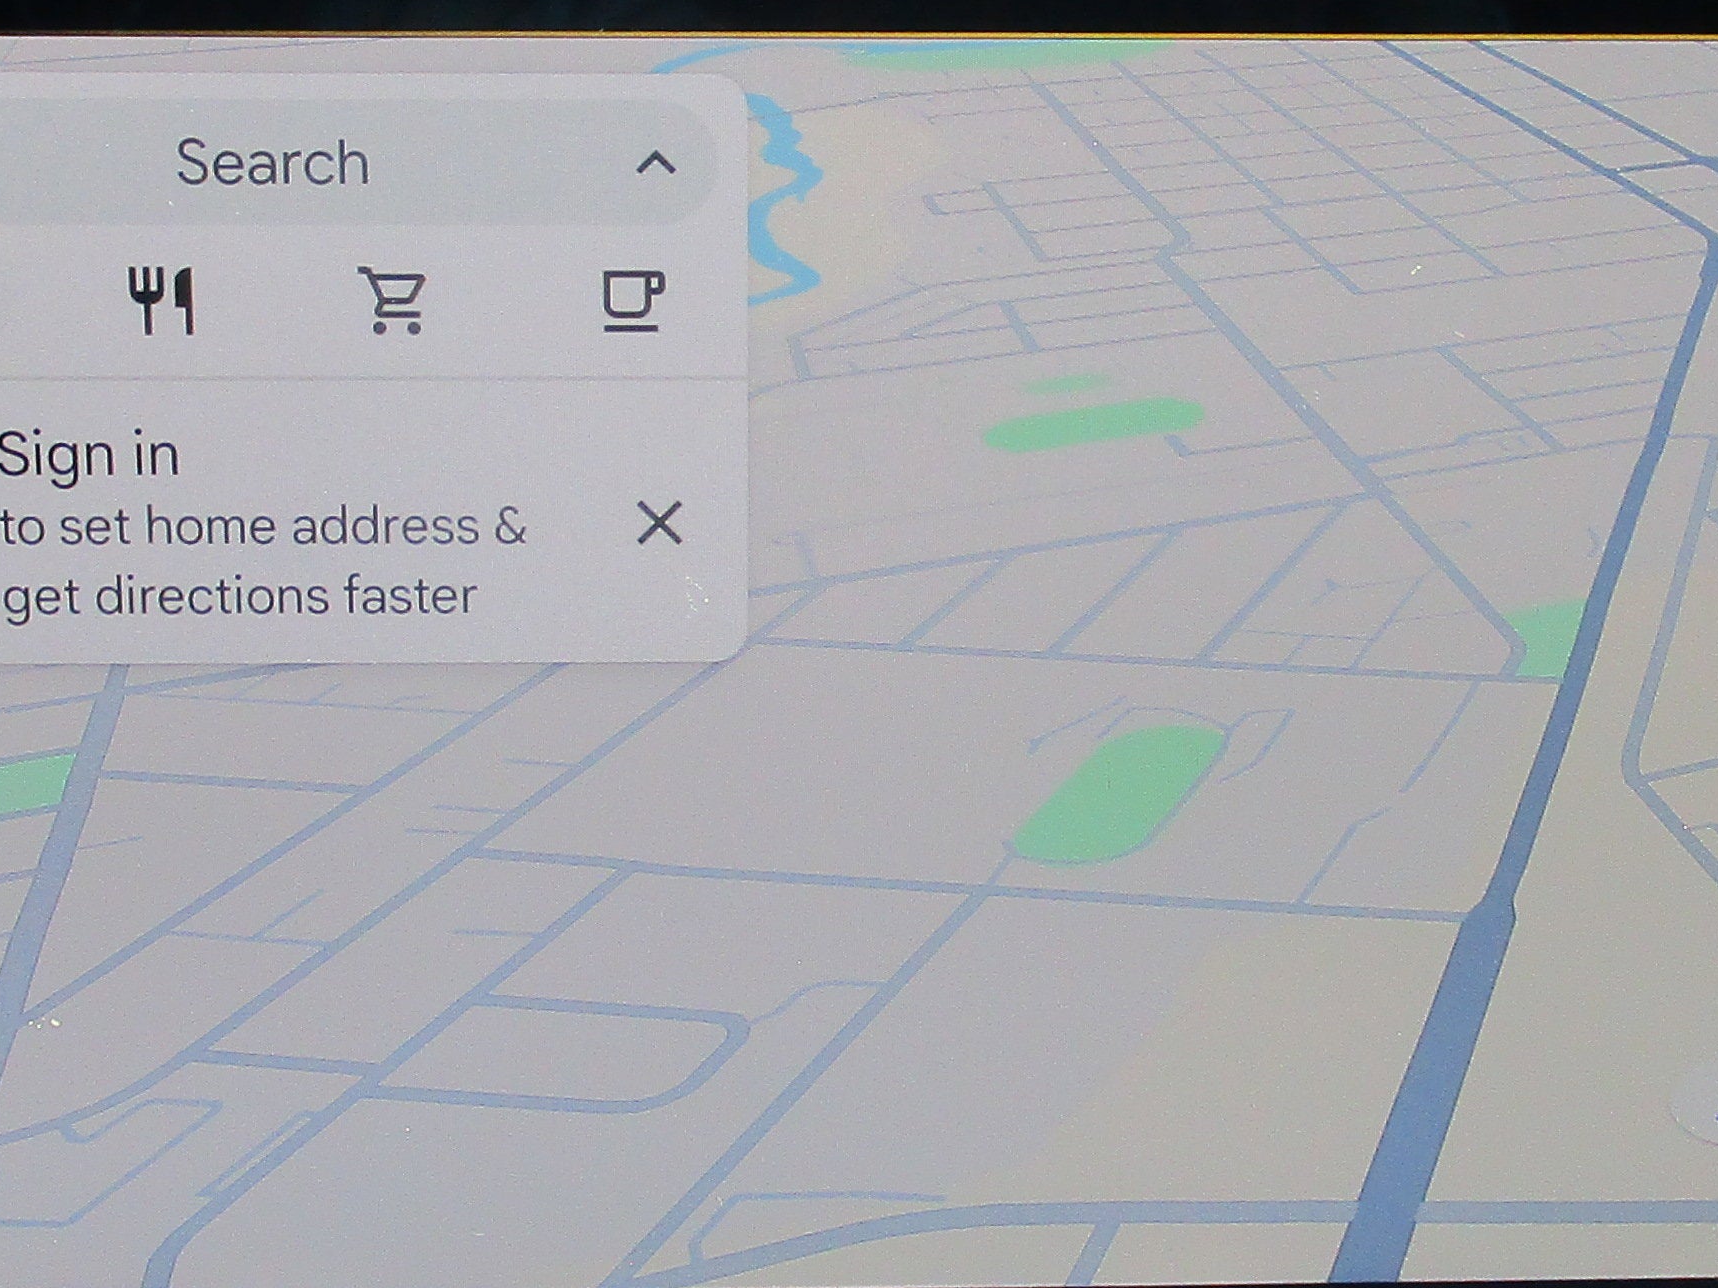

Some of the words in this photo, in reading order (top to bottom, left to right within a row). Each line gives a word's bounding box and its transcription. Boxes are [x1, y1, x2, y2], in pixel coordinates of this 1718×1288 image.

[177, 136, 370, 186] Search
[134, 428, 180, 476] in
[0, 507, 46, 546] to
[59, 508, 131, 546] set
[146, 504, 277, 546] home
[292, 503, 480, 546] address
[494, 505, 527, 545] &
[2, 579, 81, 627] get
[95, 573, 330, 615] directions
[342, 572, 479, 614] faster
